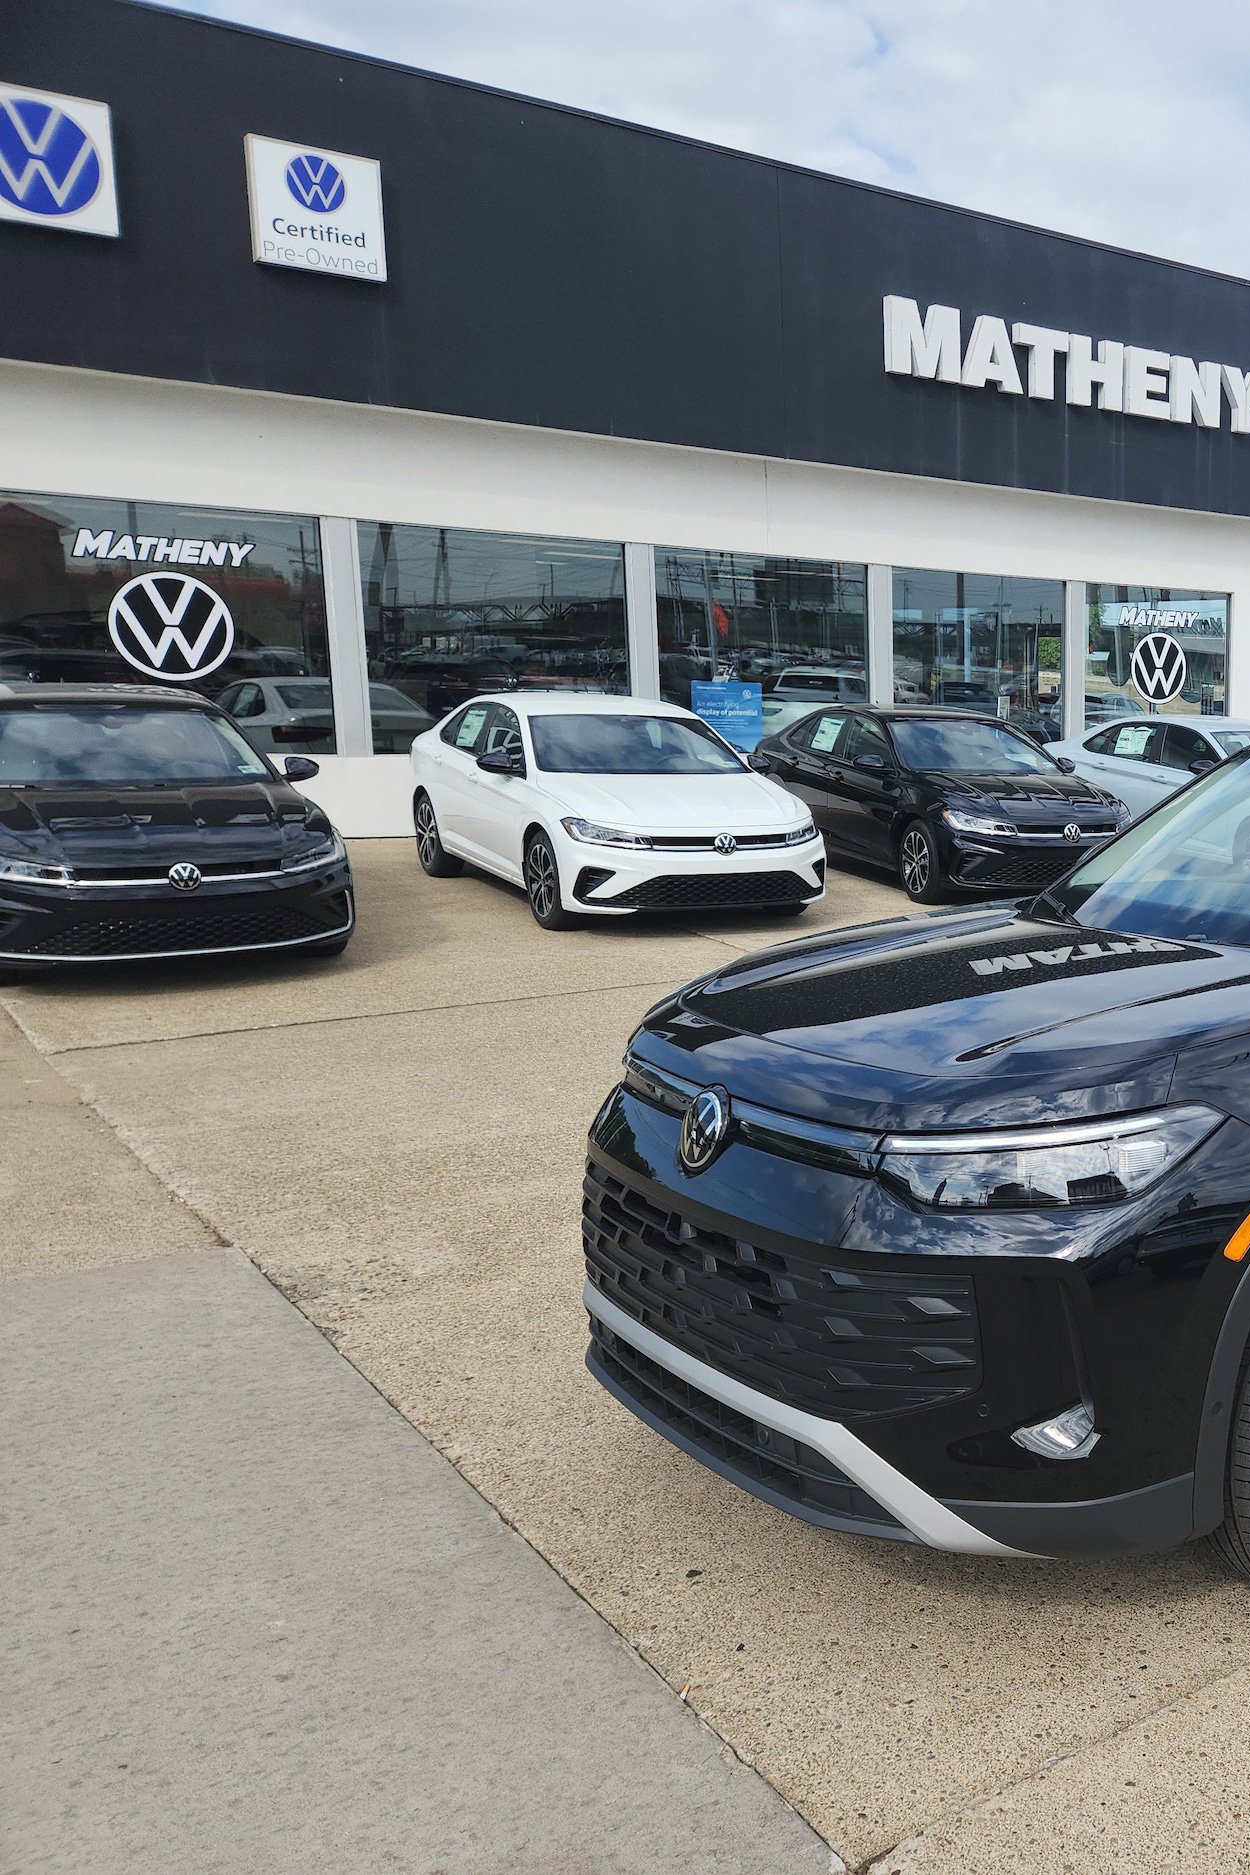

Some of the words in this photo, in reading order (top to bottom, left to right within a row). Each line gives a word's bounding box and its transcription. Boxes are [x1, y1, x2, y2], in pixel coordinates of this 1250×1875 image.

[284, 153, 347, 214] VW
[272, 217, 366, 248] Certified
[263, 240, 379, 275] Pre-Owned
[72, 527, 255, 567] MATHENY
[107, 571, 235, 682] VW
[1119, 606, 1199, 628] MATHENY
[1131, 632, 1187, 704] VW
[696, 708, 720, 716] display
[728, 709, 758, 717] potential
